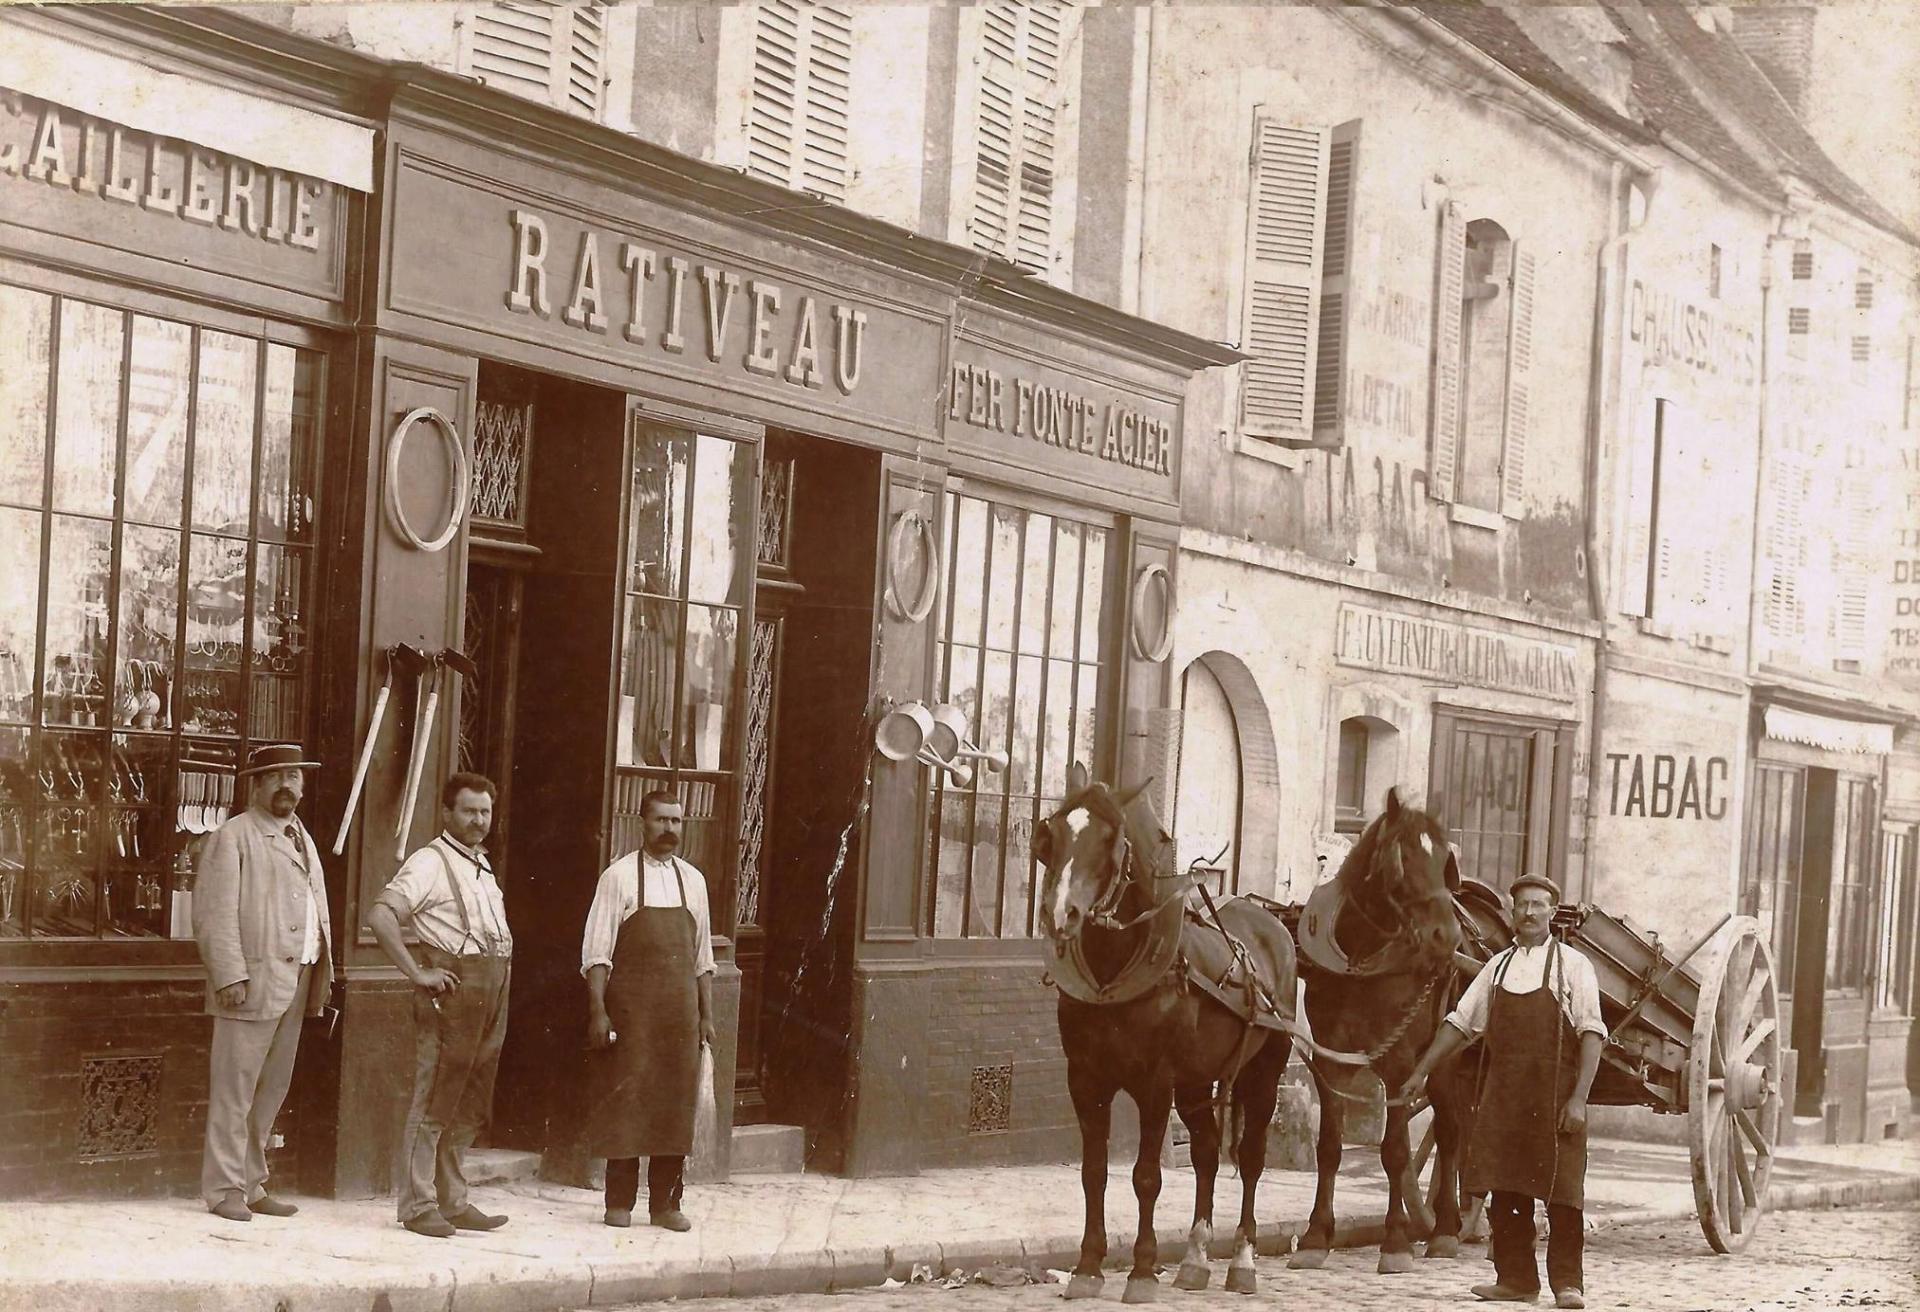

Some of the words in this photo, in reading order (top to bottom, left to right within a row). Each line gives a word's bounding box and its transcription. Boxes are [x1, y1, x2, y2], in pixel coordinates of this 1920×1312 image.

[505, 209, 868, 396] RATIVEAU
[949, 361, 1005, 433] FER
[1013, 377, 1096, 456] FONTE
[1099, 405, 1171, 477] ACIER
[1606, 752, 1728, 821] TABAC
